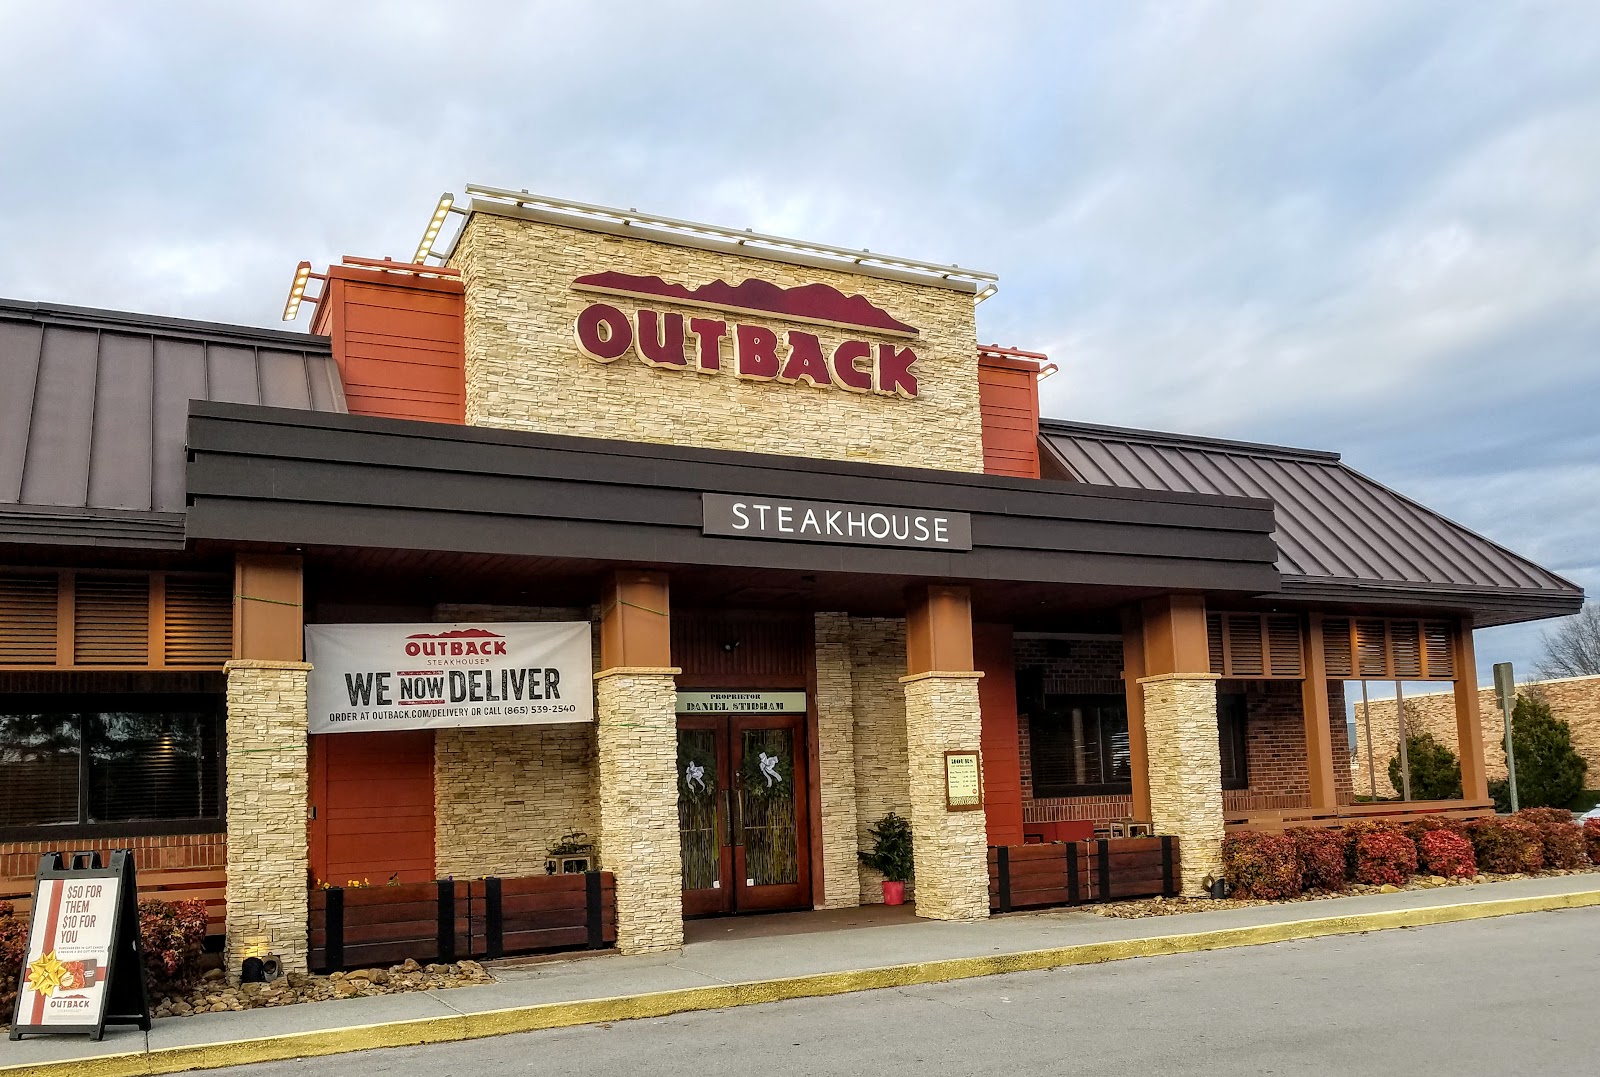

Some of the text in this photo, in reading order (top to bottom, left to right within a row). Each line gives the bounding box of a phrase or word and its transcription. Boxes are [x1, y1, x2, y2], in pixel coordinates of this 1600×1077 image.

[574, 303, 919, 398] OUTBACK
[731, 502, 950, 543] STEAKHOUSE
[405, 641, 507, 657] OUTBACK
[344, 668, 561, 707] WE NOW DELIVER
[329, 704, 576, 722] ORDER AT OUTBACK.COM/DELIVERY OR CALL (865) 539-2540
[686, 702, 784, 711] DANIEL STIDHAM
[67, 885, 102, 899] $50 FOR
[65, 900, 90, 914] THEM
[62, 915, 97, 929] $10 FOR
[61, 930, 78, 944] YOU
[50, 1000, 90, 1008] OUTBACK
